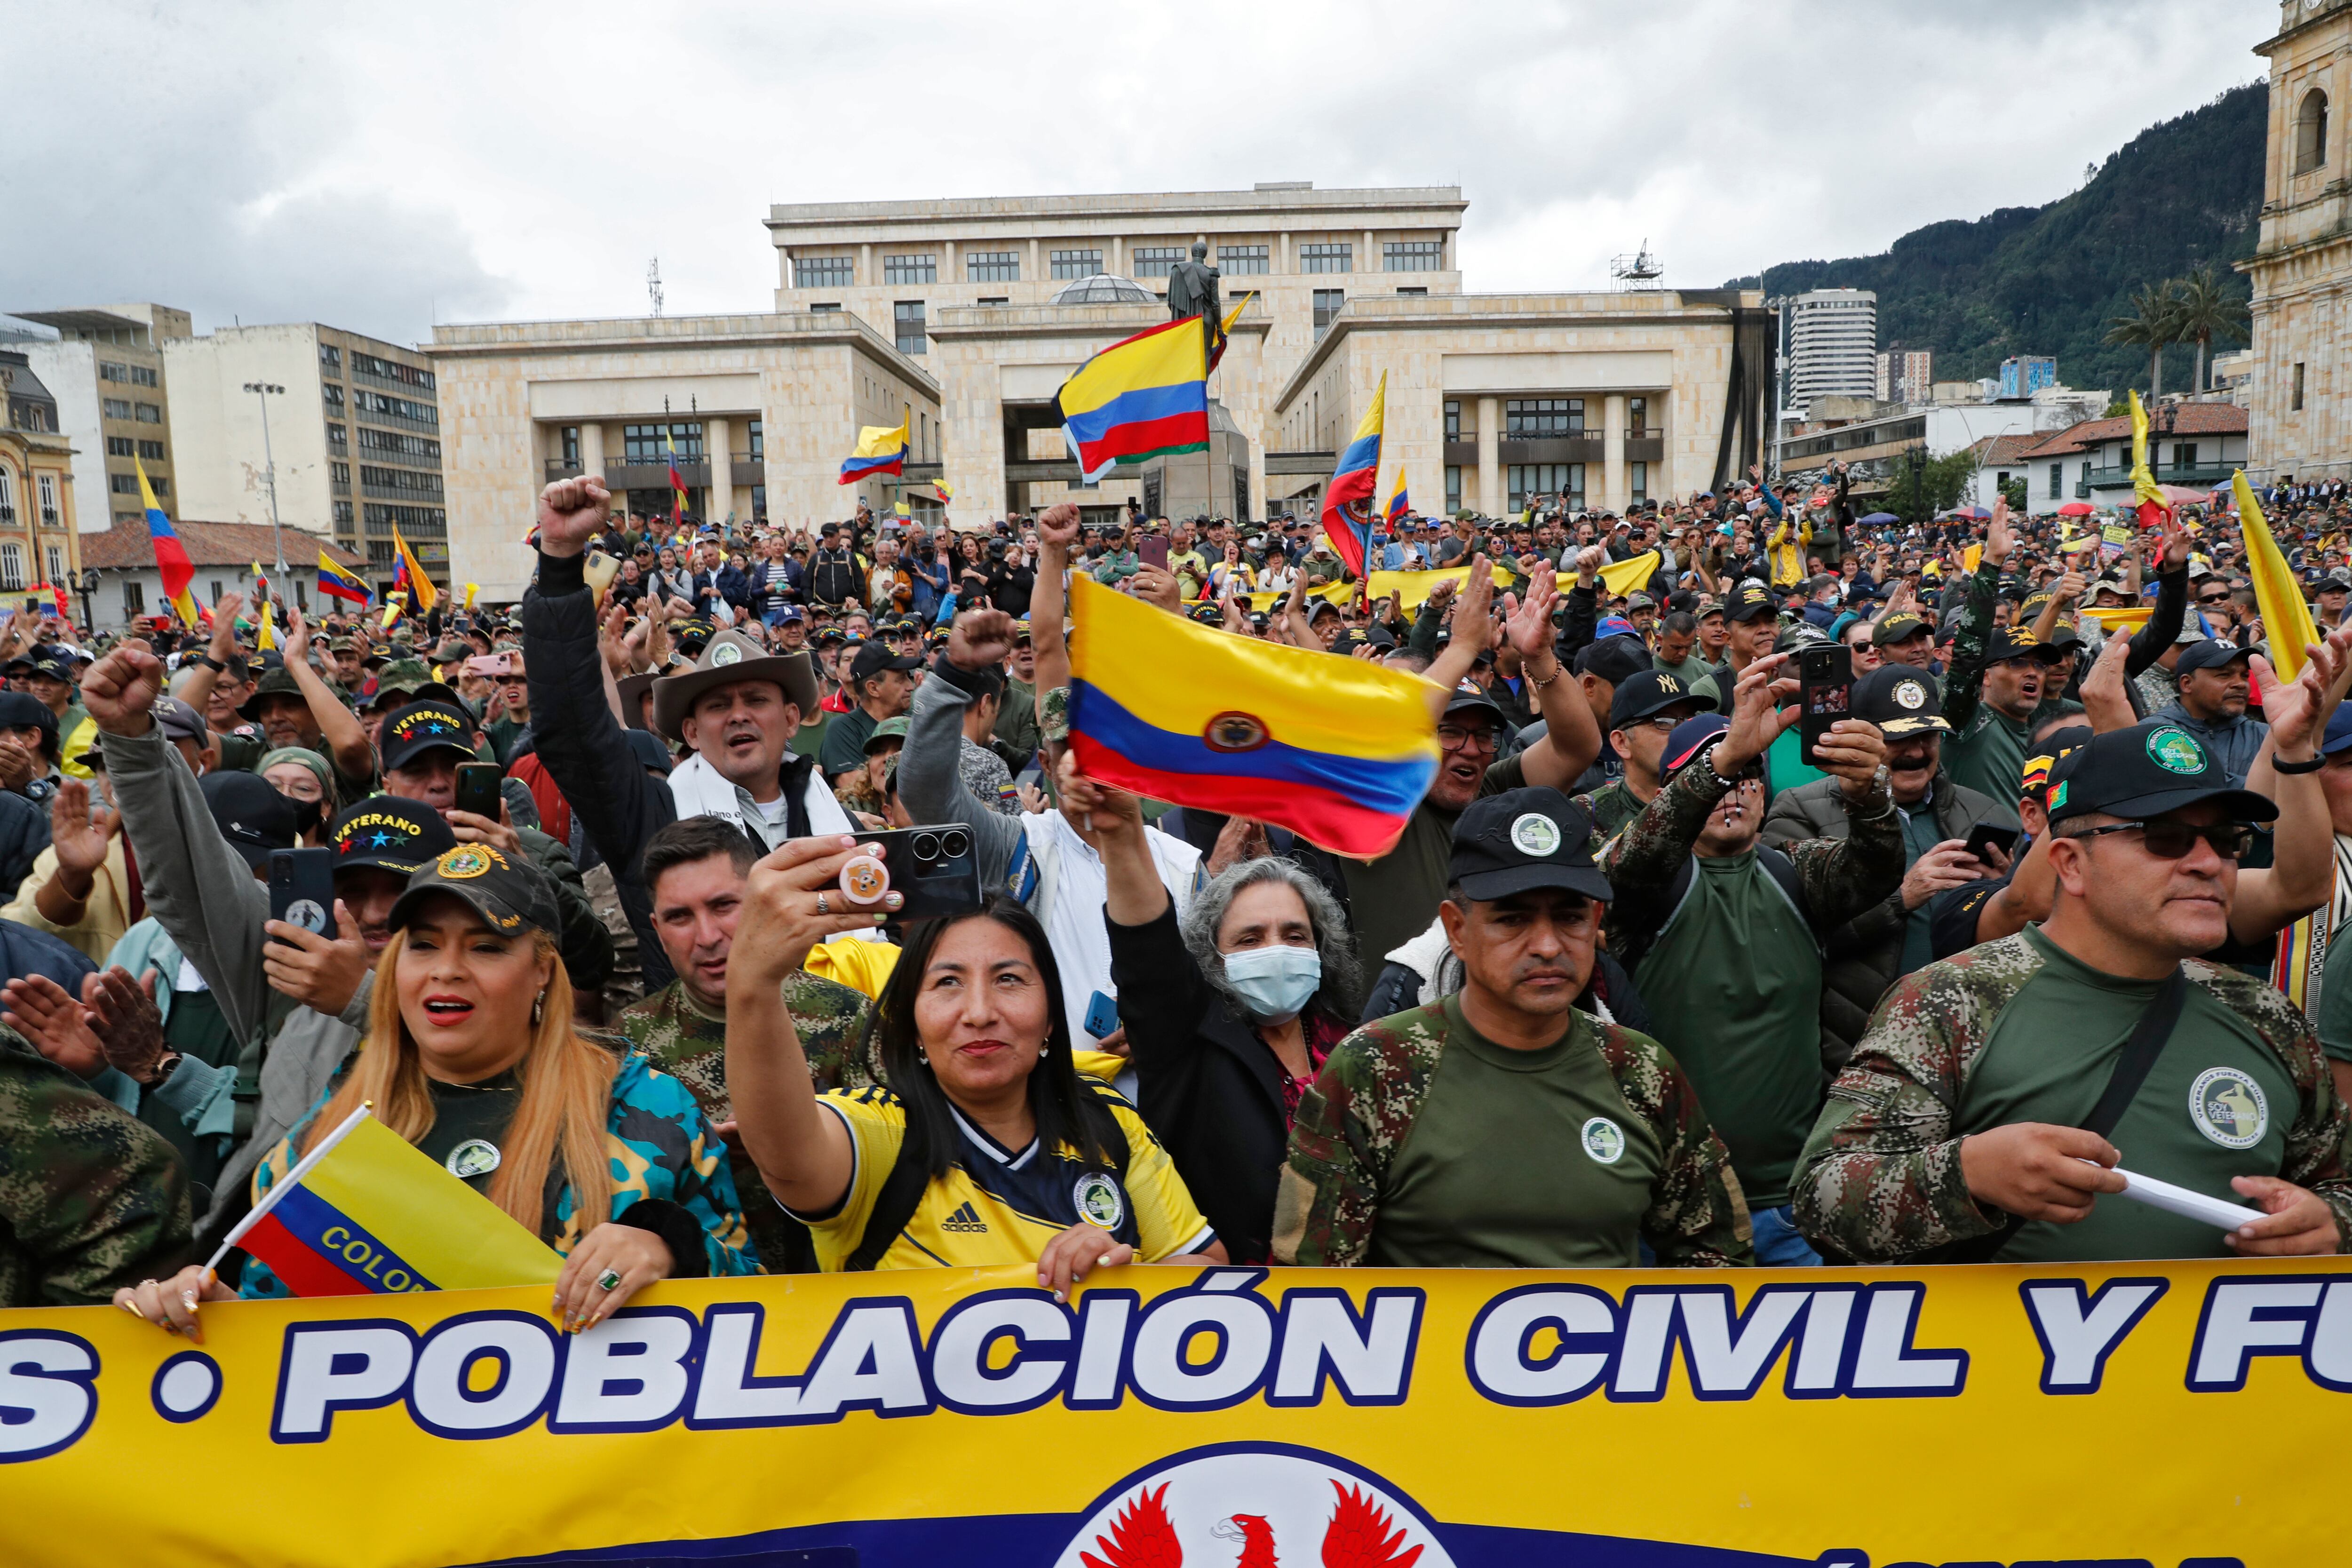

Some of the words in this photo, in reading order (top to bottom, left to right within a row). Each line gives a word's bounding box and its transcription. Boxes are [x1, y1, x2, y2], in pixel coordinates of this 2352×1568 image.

[1744, 578, 1764, 587] ARMY
[1193, 606, 1217, 617] VETERANO
[2214, 638, 2237, 649] NY
[1656, 674, 1679, 693] NY
[393, 710, 461, 735] VETERANO
[335, 813, 421, 842] VETERANO
[2195, 1074, 2214, 1119] VETERANOS
[2216, 1071, 2249, 1086] FUERZA
[2208, 1102, 2228, 1112] SOY
[2208, 1111, 2257, 1121] VETERANO
[941, 1223, 987, 1233] adidas
[270, 1266, 1426, 1444] POBLACIÓN
[1466, 1281, 1969, 1408] CIVIL
[2019, 1277, 2170, 1395] Y
